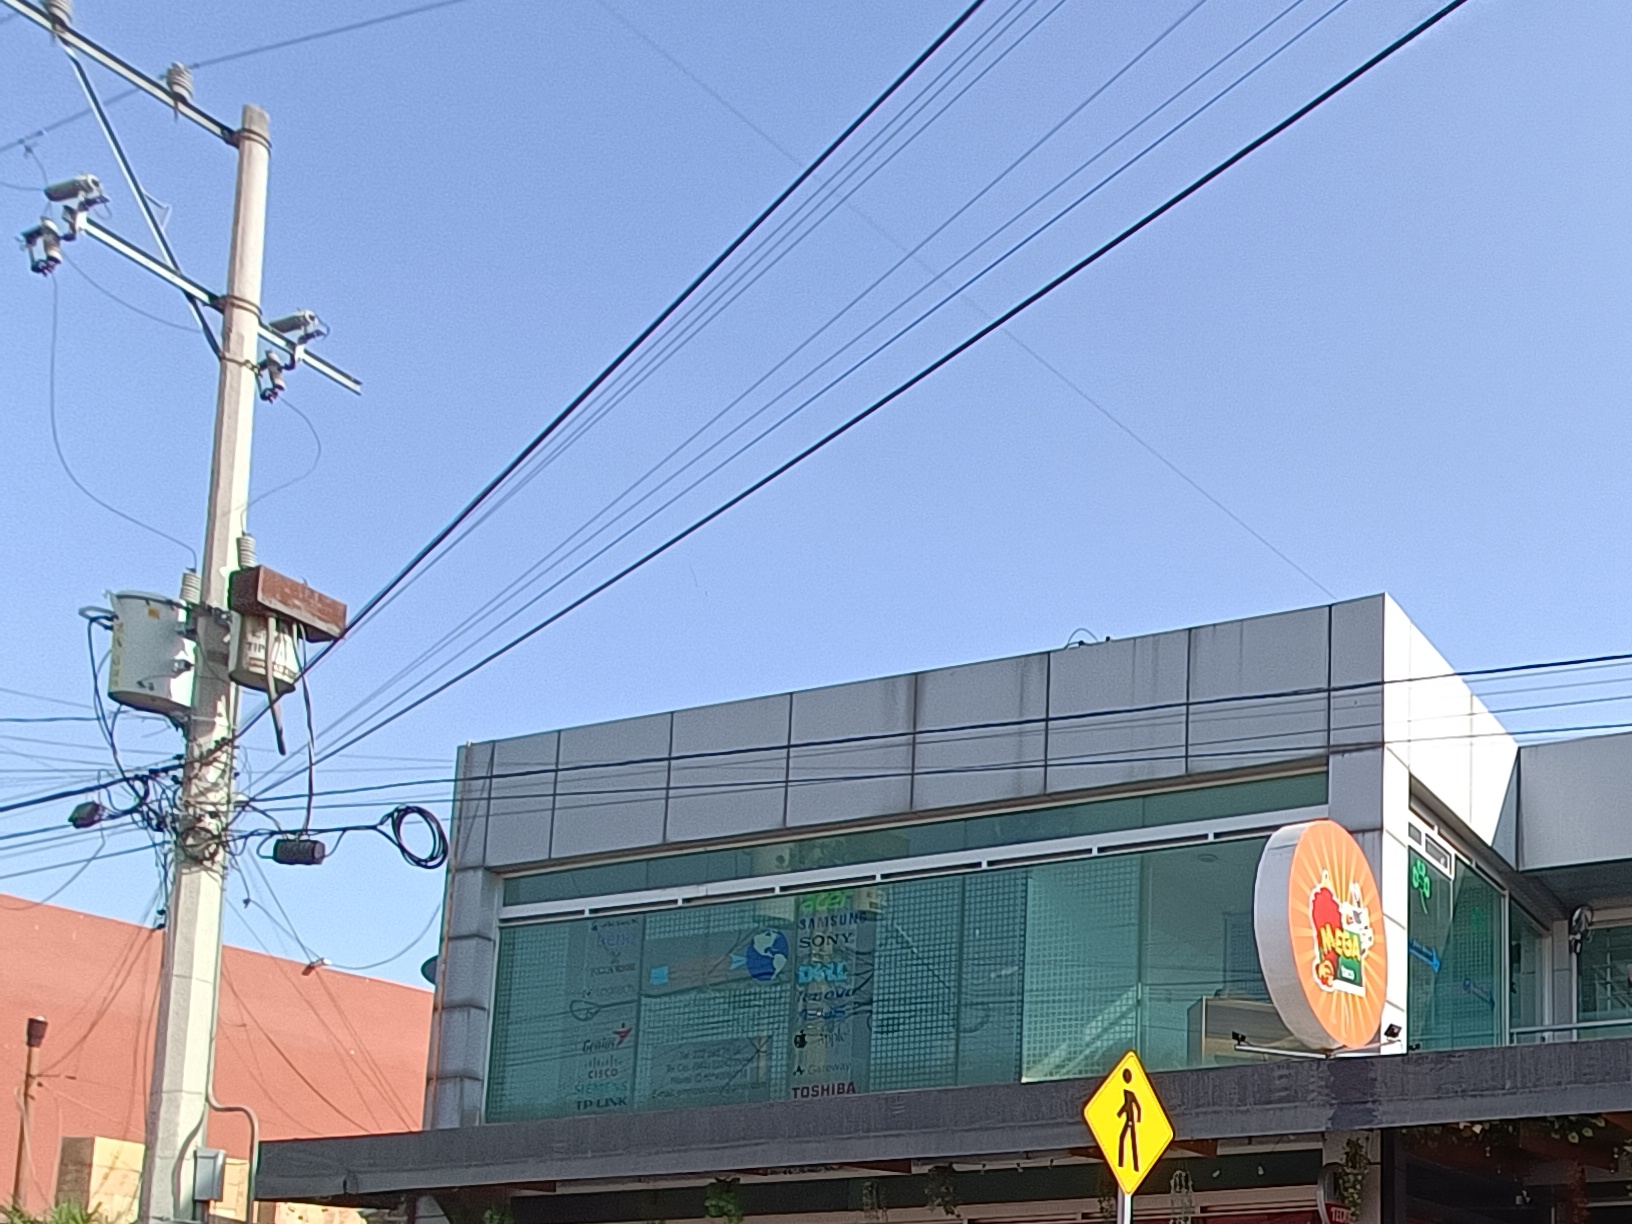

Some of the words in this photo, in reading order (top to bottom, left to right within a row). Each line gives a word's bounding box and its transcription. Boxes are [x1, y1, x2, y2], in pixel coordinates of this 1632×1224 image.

[800, 912, 867, 930] SAMSUNG
[799, 932, 853, 948] SONY
[792, 1081, 856, 1099] TOSHIBA
